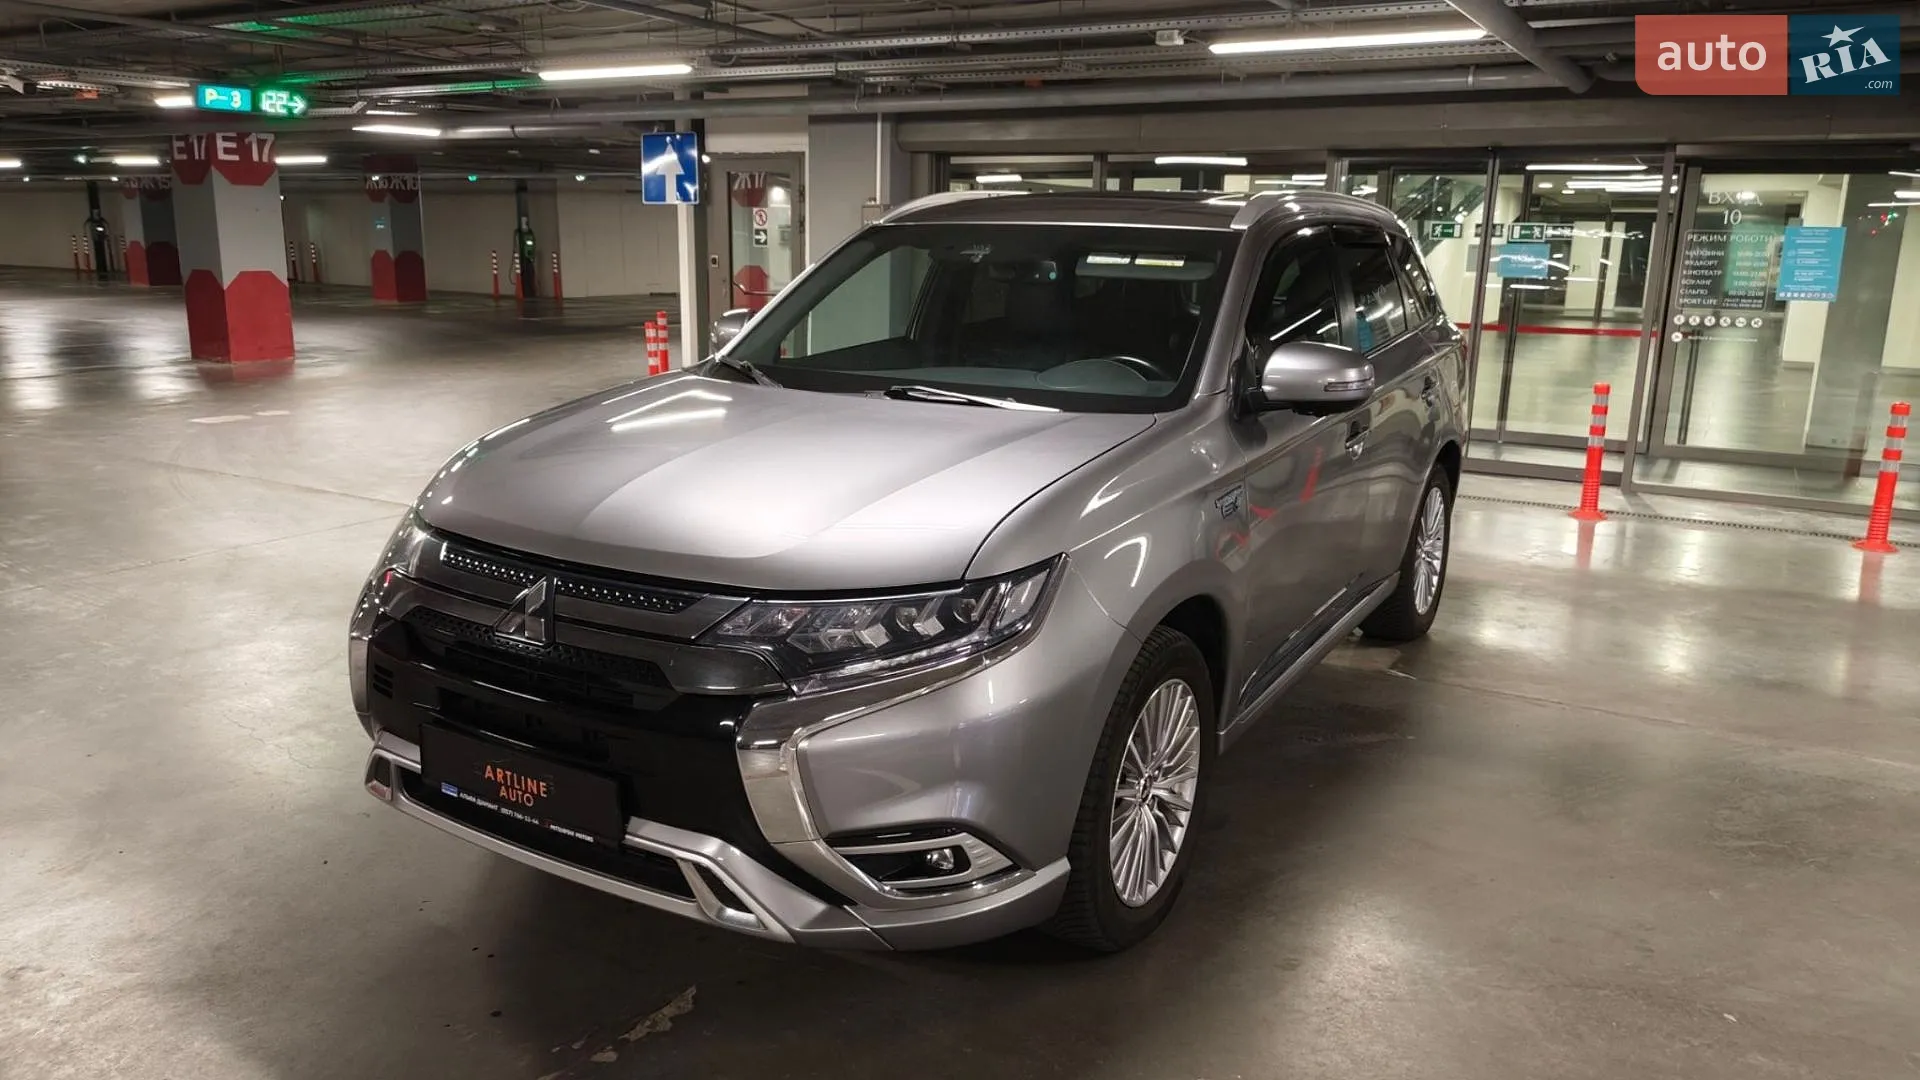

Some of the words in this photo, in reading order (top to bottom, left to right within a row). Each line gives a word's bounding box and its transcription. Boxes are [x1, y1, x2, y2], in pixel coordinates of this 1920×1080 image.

[244, 132, 275, 162] 17
[1723, 208, 1742, 225] 10
[1687, 233, 1727, 243] РЕЖИМ
[484, 764, 548, 798] ARTLINE
[499, 785, 534, 807] AUTO
